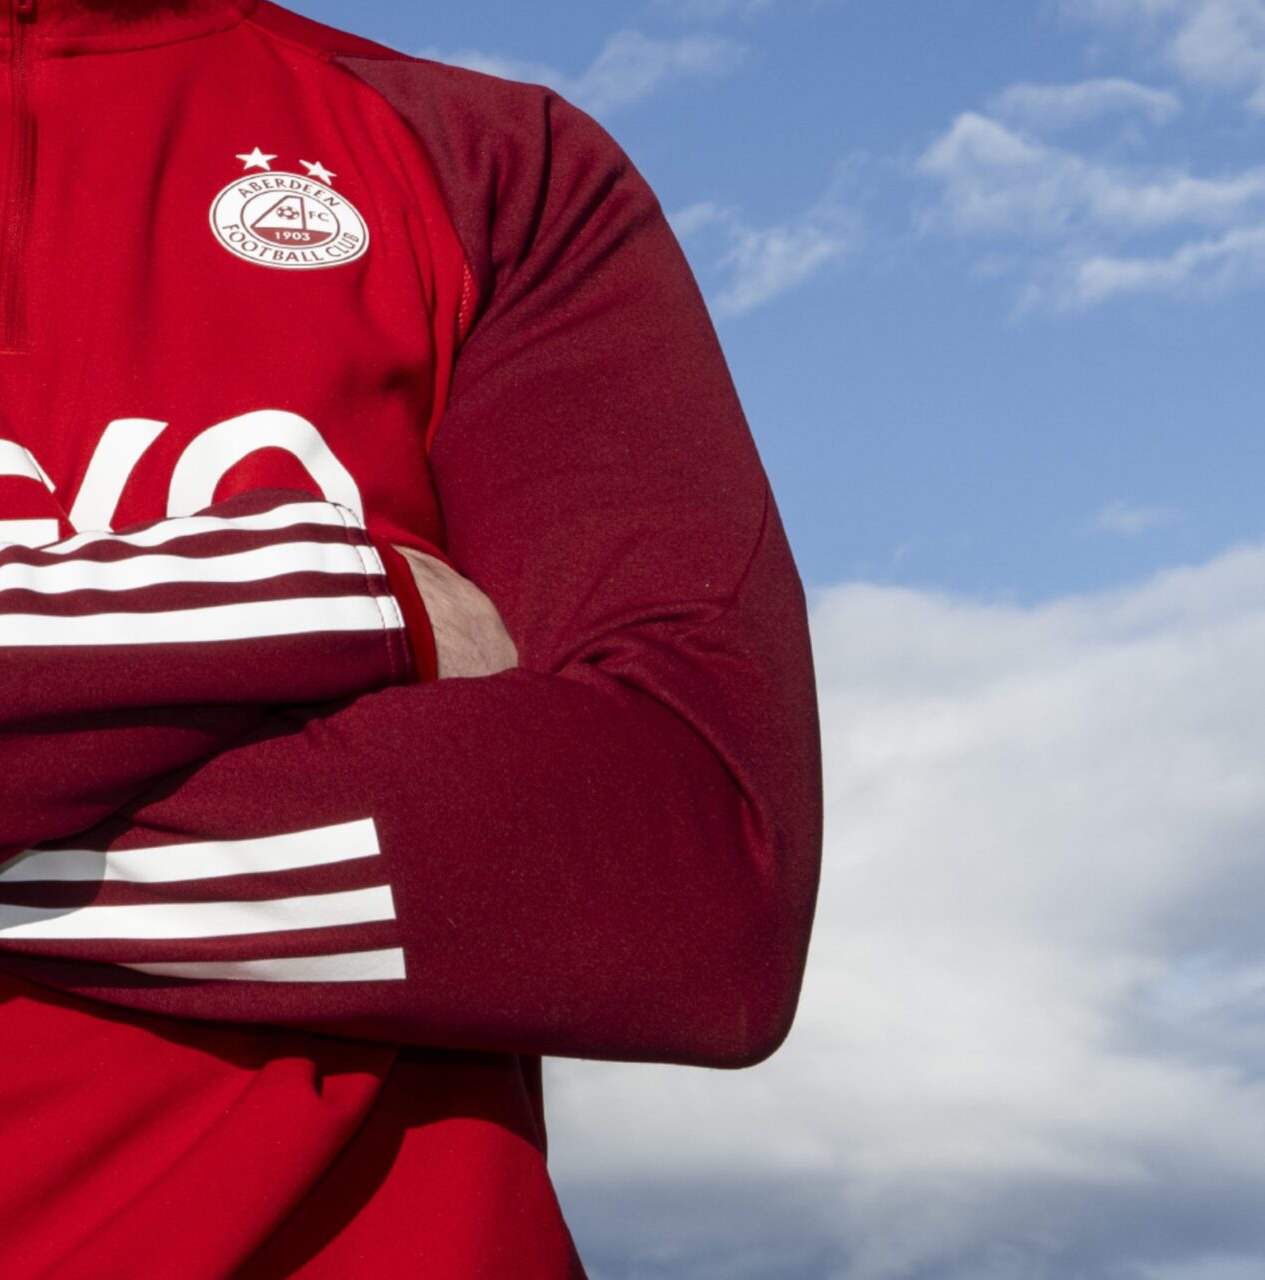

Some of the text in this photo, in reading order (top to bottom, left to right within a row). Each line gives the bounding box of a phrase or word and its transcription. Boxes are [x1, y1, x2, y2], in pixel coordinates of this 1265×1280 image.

[237, 177, 340, 207] ABERDEEN
[308, 210, 330, 222] FC
[222, 223, 359, 262] FOOTBALL CLUB
[275, 231, 311, 241] 1903
